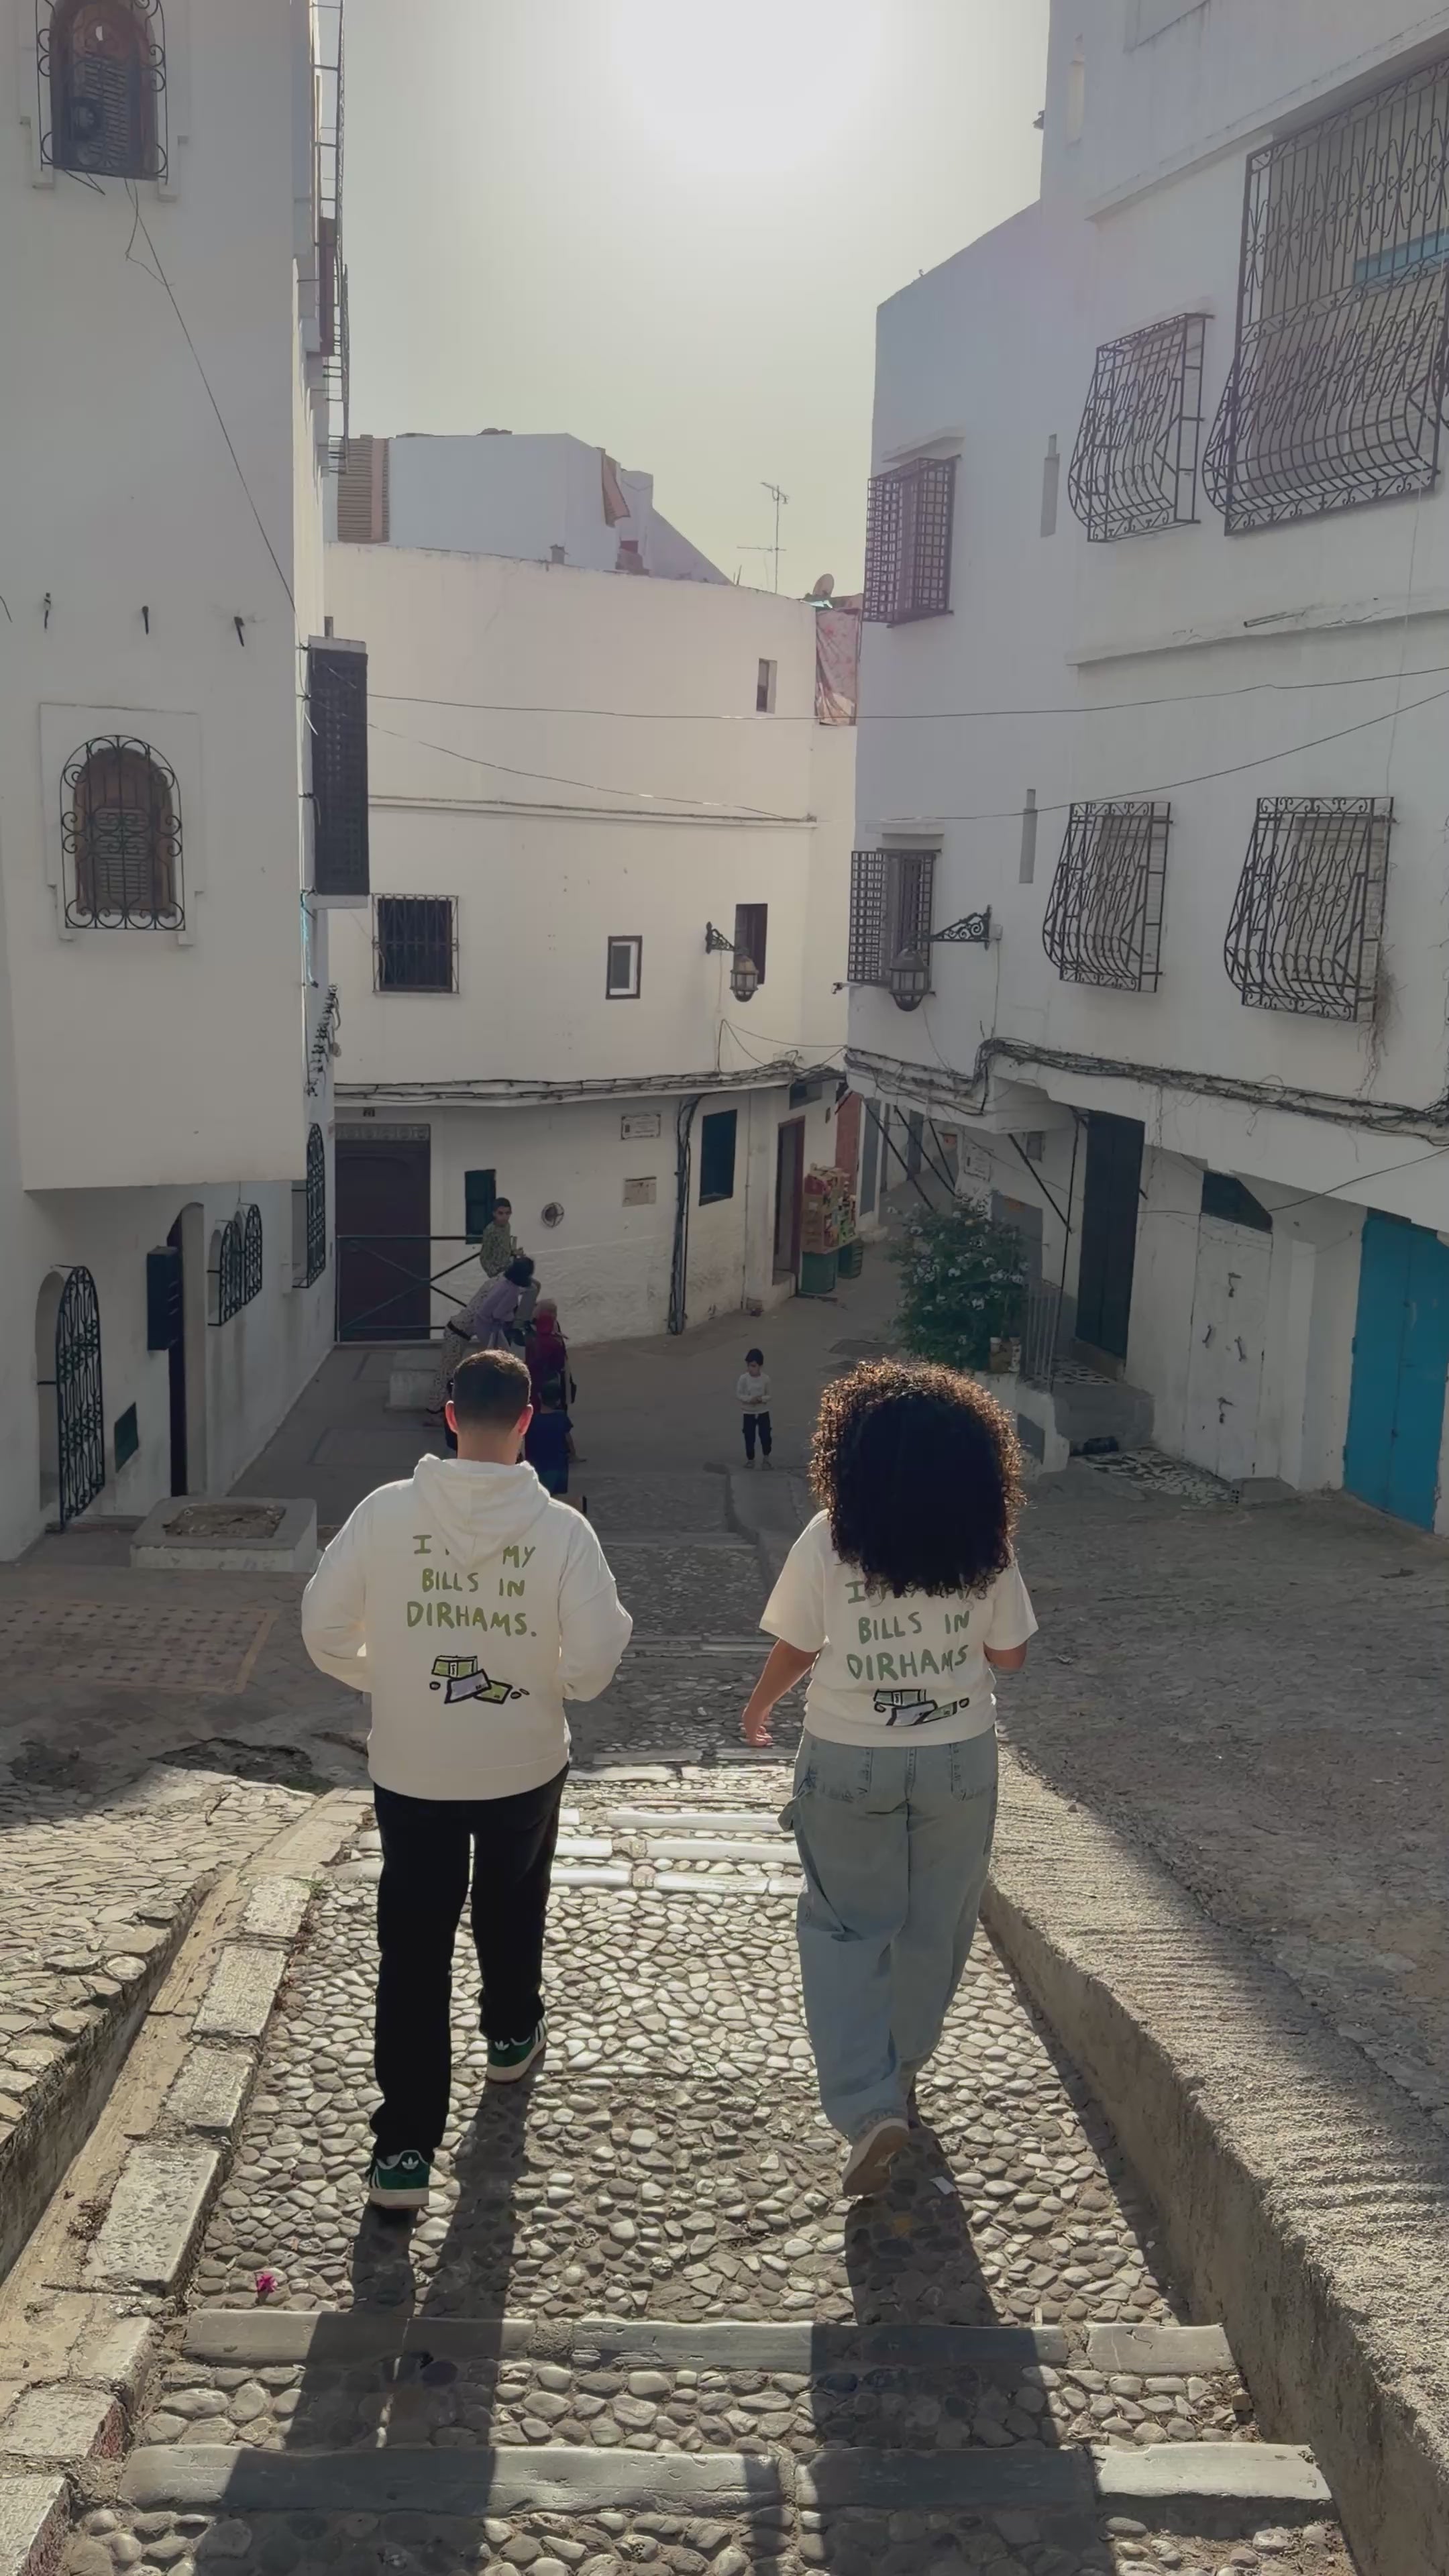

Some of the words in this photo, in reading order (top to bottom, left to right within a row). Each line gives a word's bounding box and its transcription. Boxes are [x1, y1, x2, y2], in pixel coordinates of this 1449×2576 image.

[413, 1534, 432, 1554] I
[502, 1545, 536, 1568] MY
[422, 1568, 479, 1593] BILLS
[498, 1578, 525, 1597] IN
[845, 1580, 866, 1604] I
[407, 1601, 537, 1637] DIRHAMS.
[858, 1611, 922, 1644] BILLS
[945, 1610, 970, 1635] IN
[846, 1645, 969, 1681] DIRHAMS
